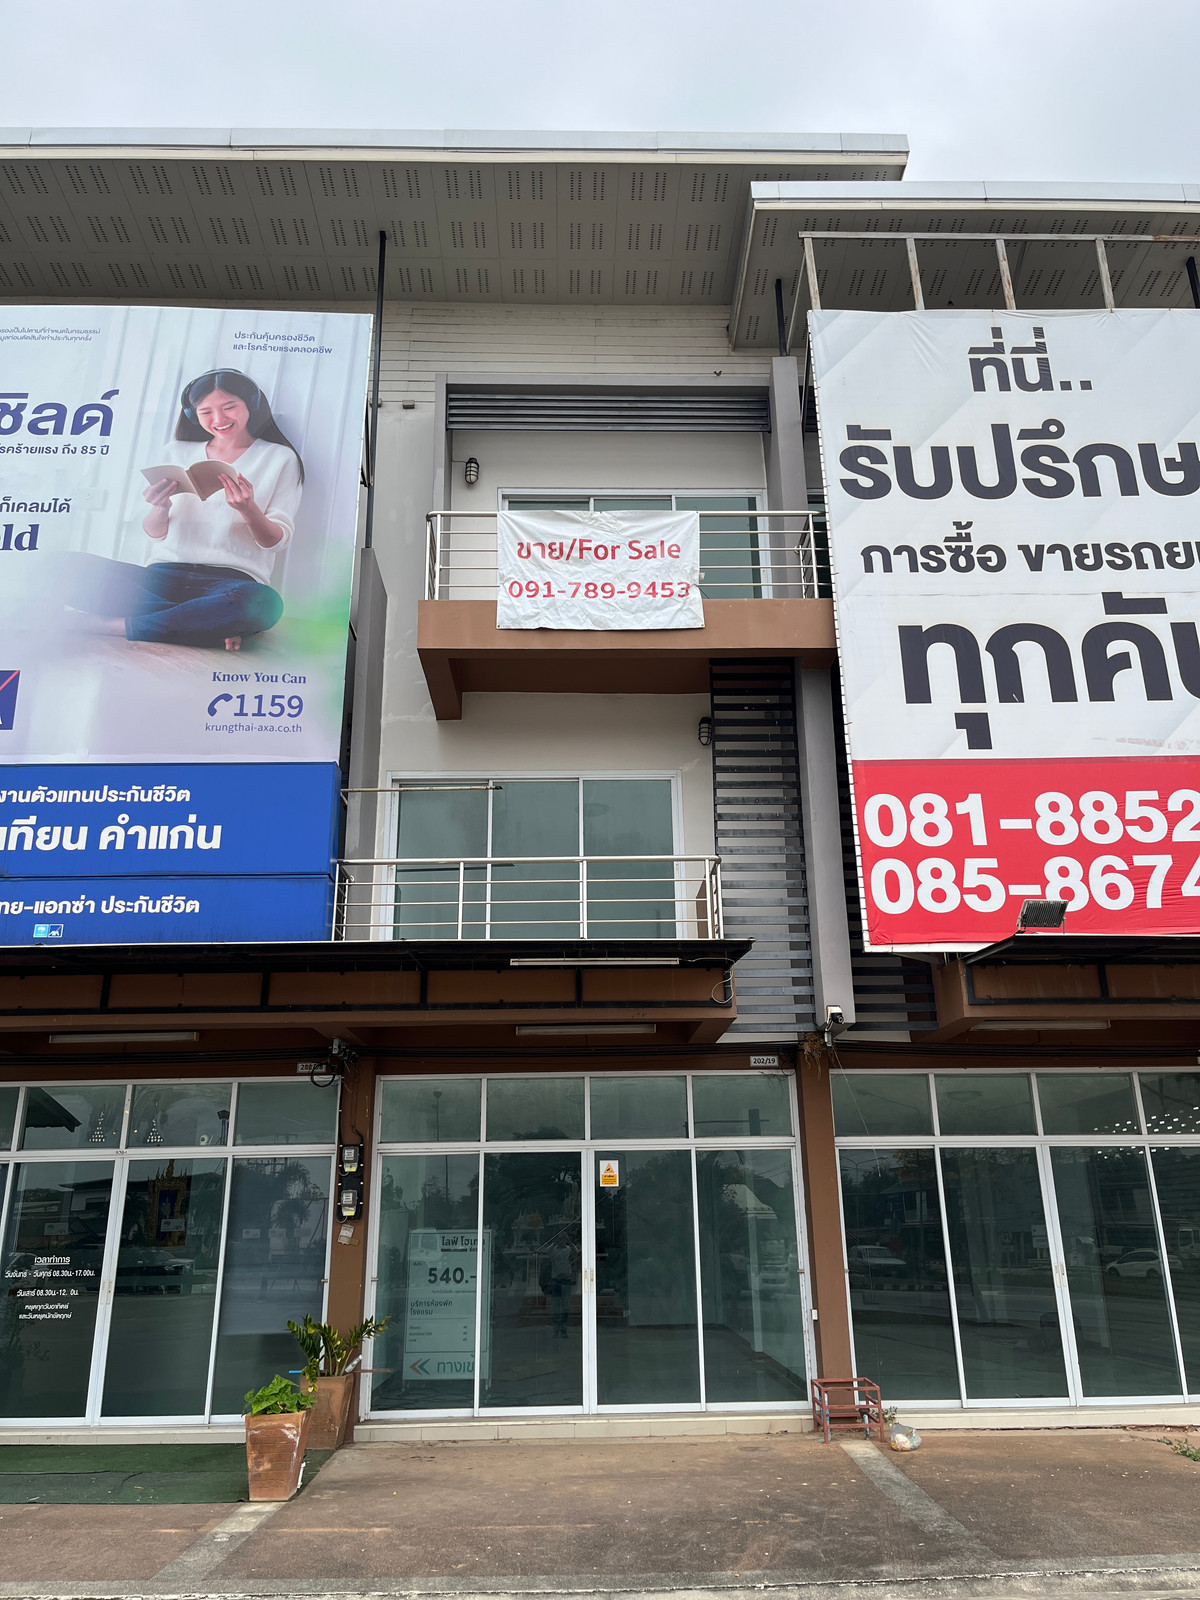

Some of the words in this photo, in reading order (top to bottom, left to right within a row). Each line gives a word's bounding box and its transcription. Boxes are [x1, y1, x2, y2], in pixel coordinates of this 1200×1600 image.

[234, 331, 316, 342] ประกันคุ้มครองชีวิต
[232, 342, 333, 355] และโรคร้ายแรงตลอดชีพ
[969, 327, 1093, 393] ที่นี่..
[0, 443, 59, 455] รคร้ายแรง
[61, 443, 77, 455] ถึง
[80, 445, 97, 455] 85
[100, 444, 110, 456] ปี
[839, 418, 1200, 500] รับปรึกษ
[0, 495, 73, 513] ก็เคลมได้
[0, 523, 40, 551] ld
[517, 538, 621, 561] ขาย/For
[627, 540, 682, 560] Sale
[860, 521, 1007, 574] การซื้อ
[508, 581, 691, 599] 091-789-9453
[212, 671, 251, 682] Know
[254, 672, 279, 683] You
[281, 673, 307, 684] Can
[233, 693, 304, 718] 1159
[205, 722, 303, 734] krungthai-axa.co.th
[863, 788, 1200, 848] 081-8852
[98, 813, 223, 850] คำแก่น
[100, 894, 200, 914] ประกันชีวิต
[753, 1057, 776, 1065] 202/19
[34, 1254, 71, 1264] เวลาทำการ
[437, 1353, 475, 1374] ทางเข้
